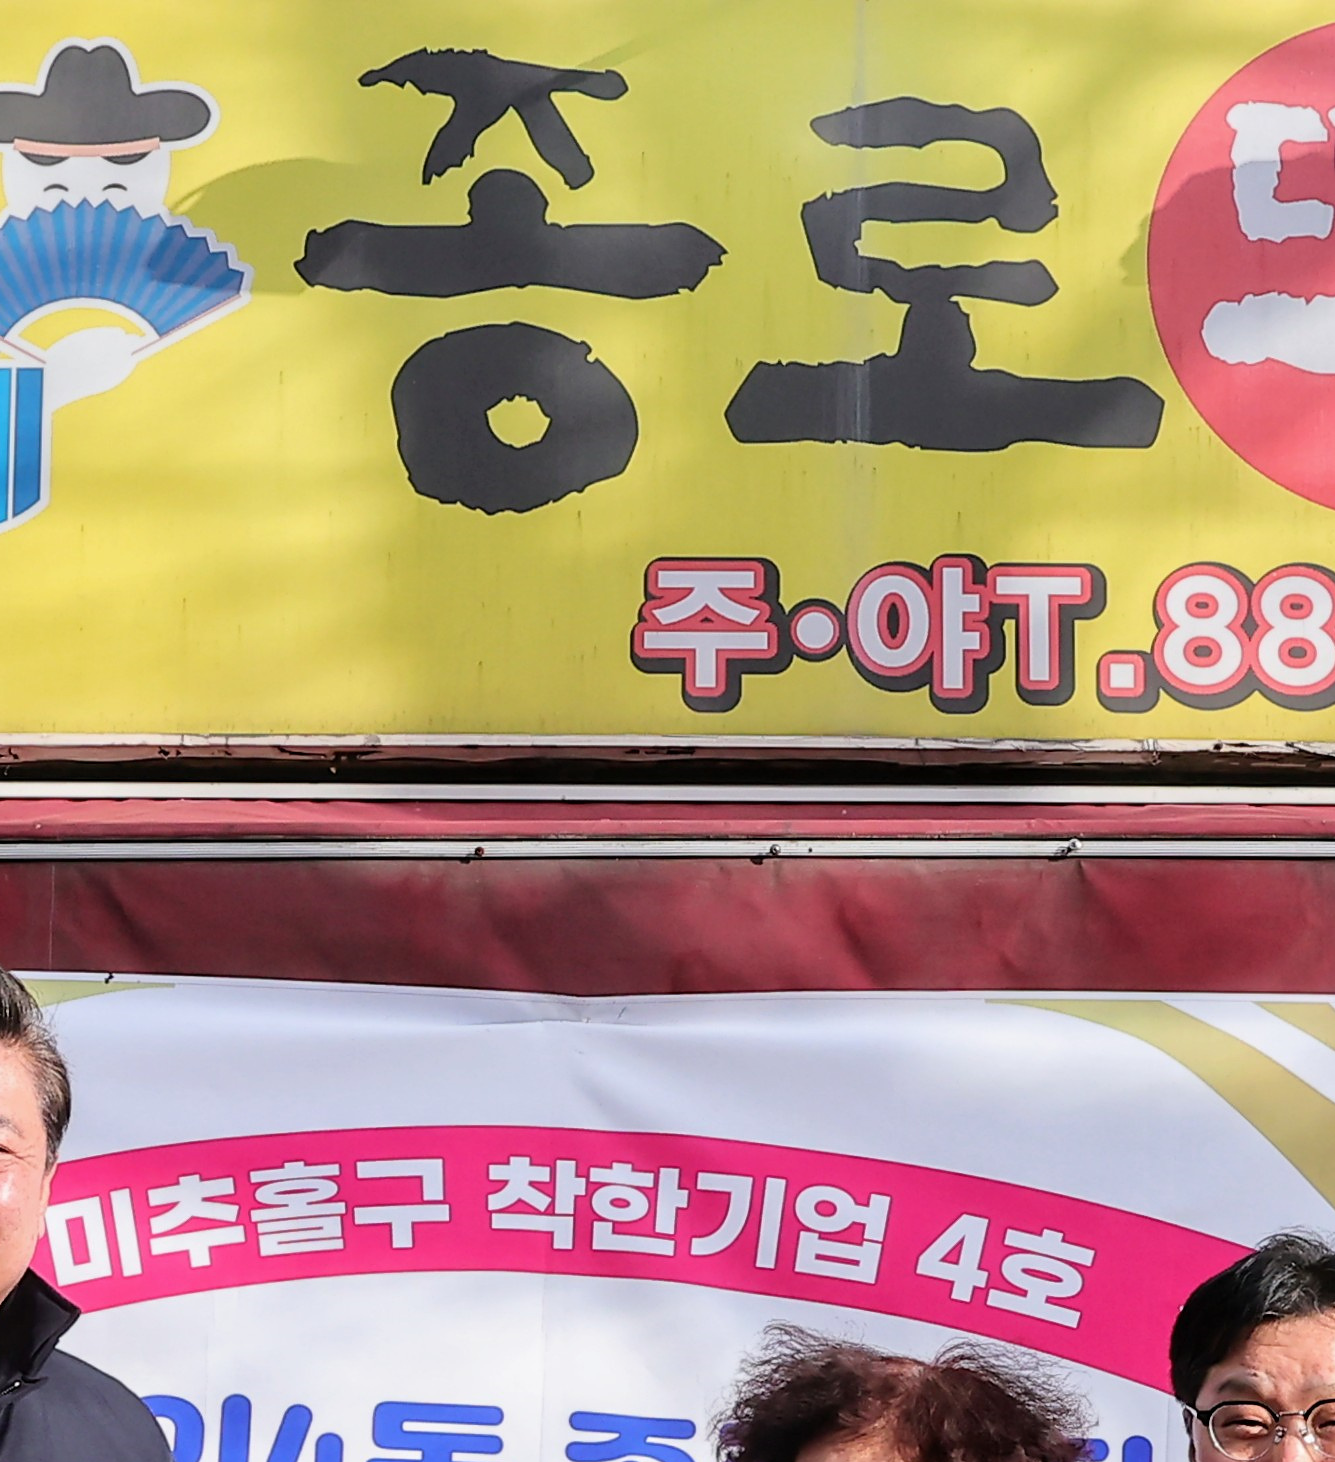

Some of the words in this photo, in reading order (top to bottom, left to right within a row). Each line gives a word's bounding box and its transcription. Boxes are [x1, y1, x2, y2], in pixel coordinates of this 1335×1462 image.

[45, 1160, 450, 1287] 미추홀구
[487, 1156, 892, 1284] 착한기업
[916, 1213, 1096, 1329] 4호
